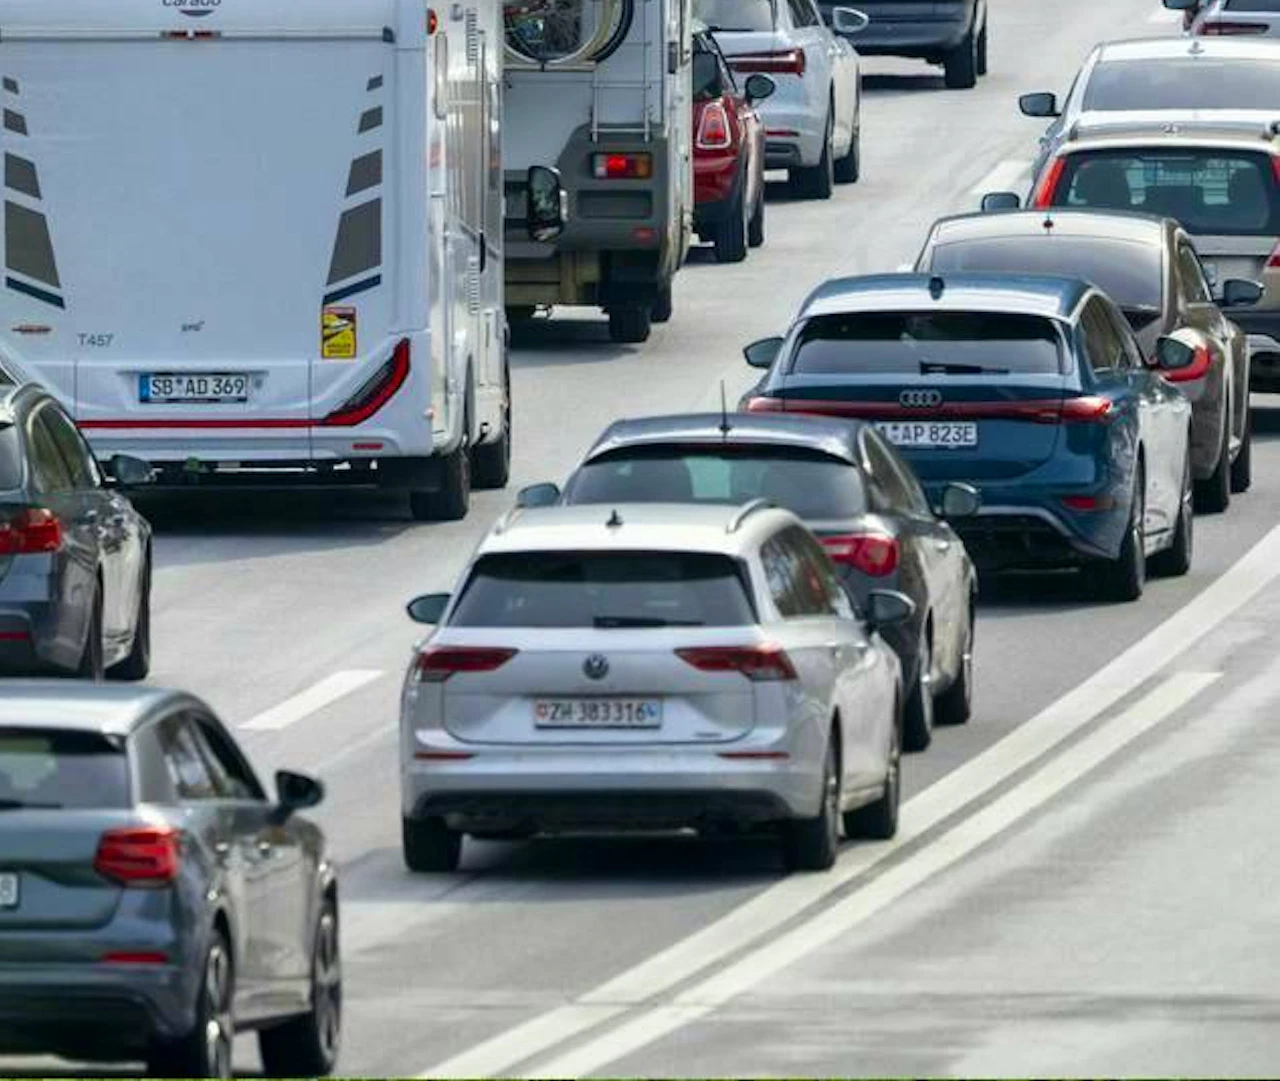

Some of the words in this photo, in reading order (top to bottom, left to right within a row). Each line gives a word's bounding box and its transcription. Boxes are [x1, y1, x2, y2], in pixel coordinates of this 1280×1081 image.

[77, 333, 115, 347] T457
[152, 379, 173, 395] SB
[186, 379, 208, 395] AD
[212, 379, 244, 395] 369
[930, 425, 973, 443] 823E
